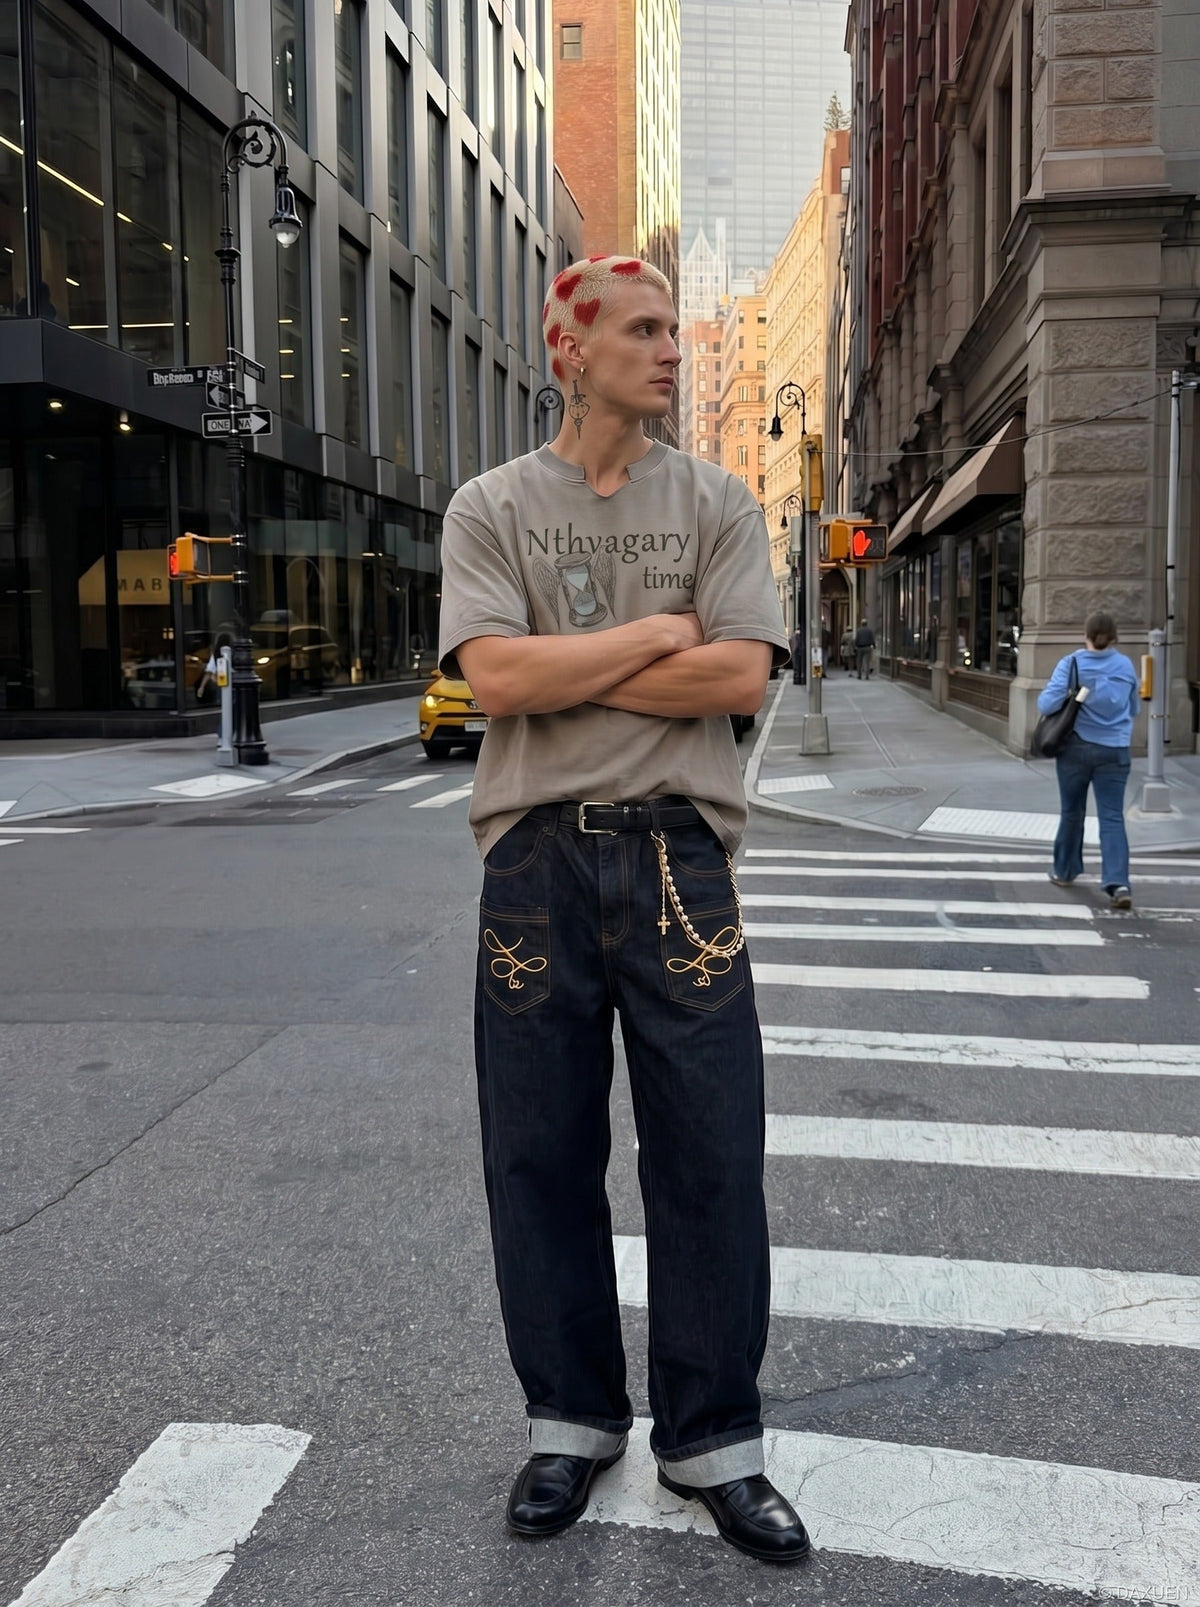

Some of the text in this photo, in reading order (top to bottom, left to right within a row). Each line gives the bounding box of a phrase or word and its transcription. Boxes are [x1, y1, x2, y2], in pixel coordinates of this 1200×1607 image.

[211, 419, 252, 430] ONE WA
[526, 522, 691, 564] Nthvagary
[117, 578, 168, 591] MAB
[642, 566, 693, 589] time
